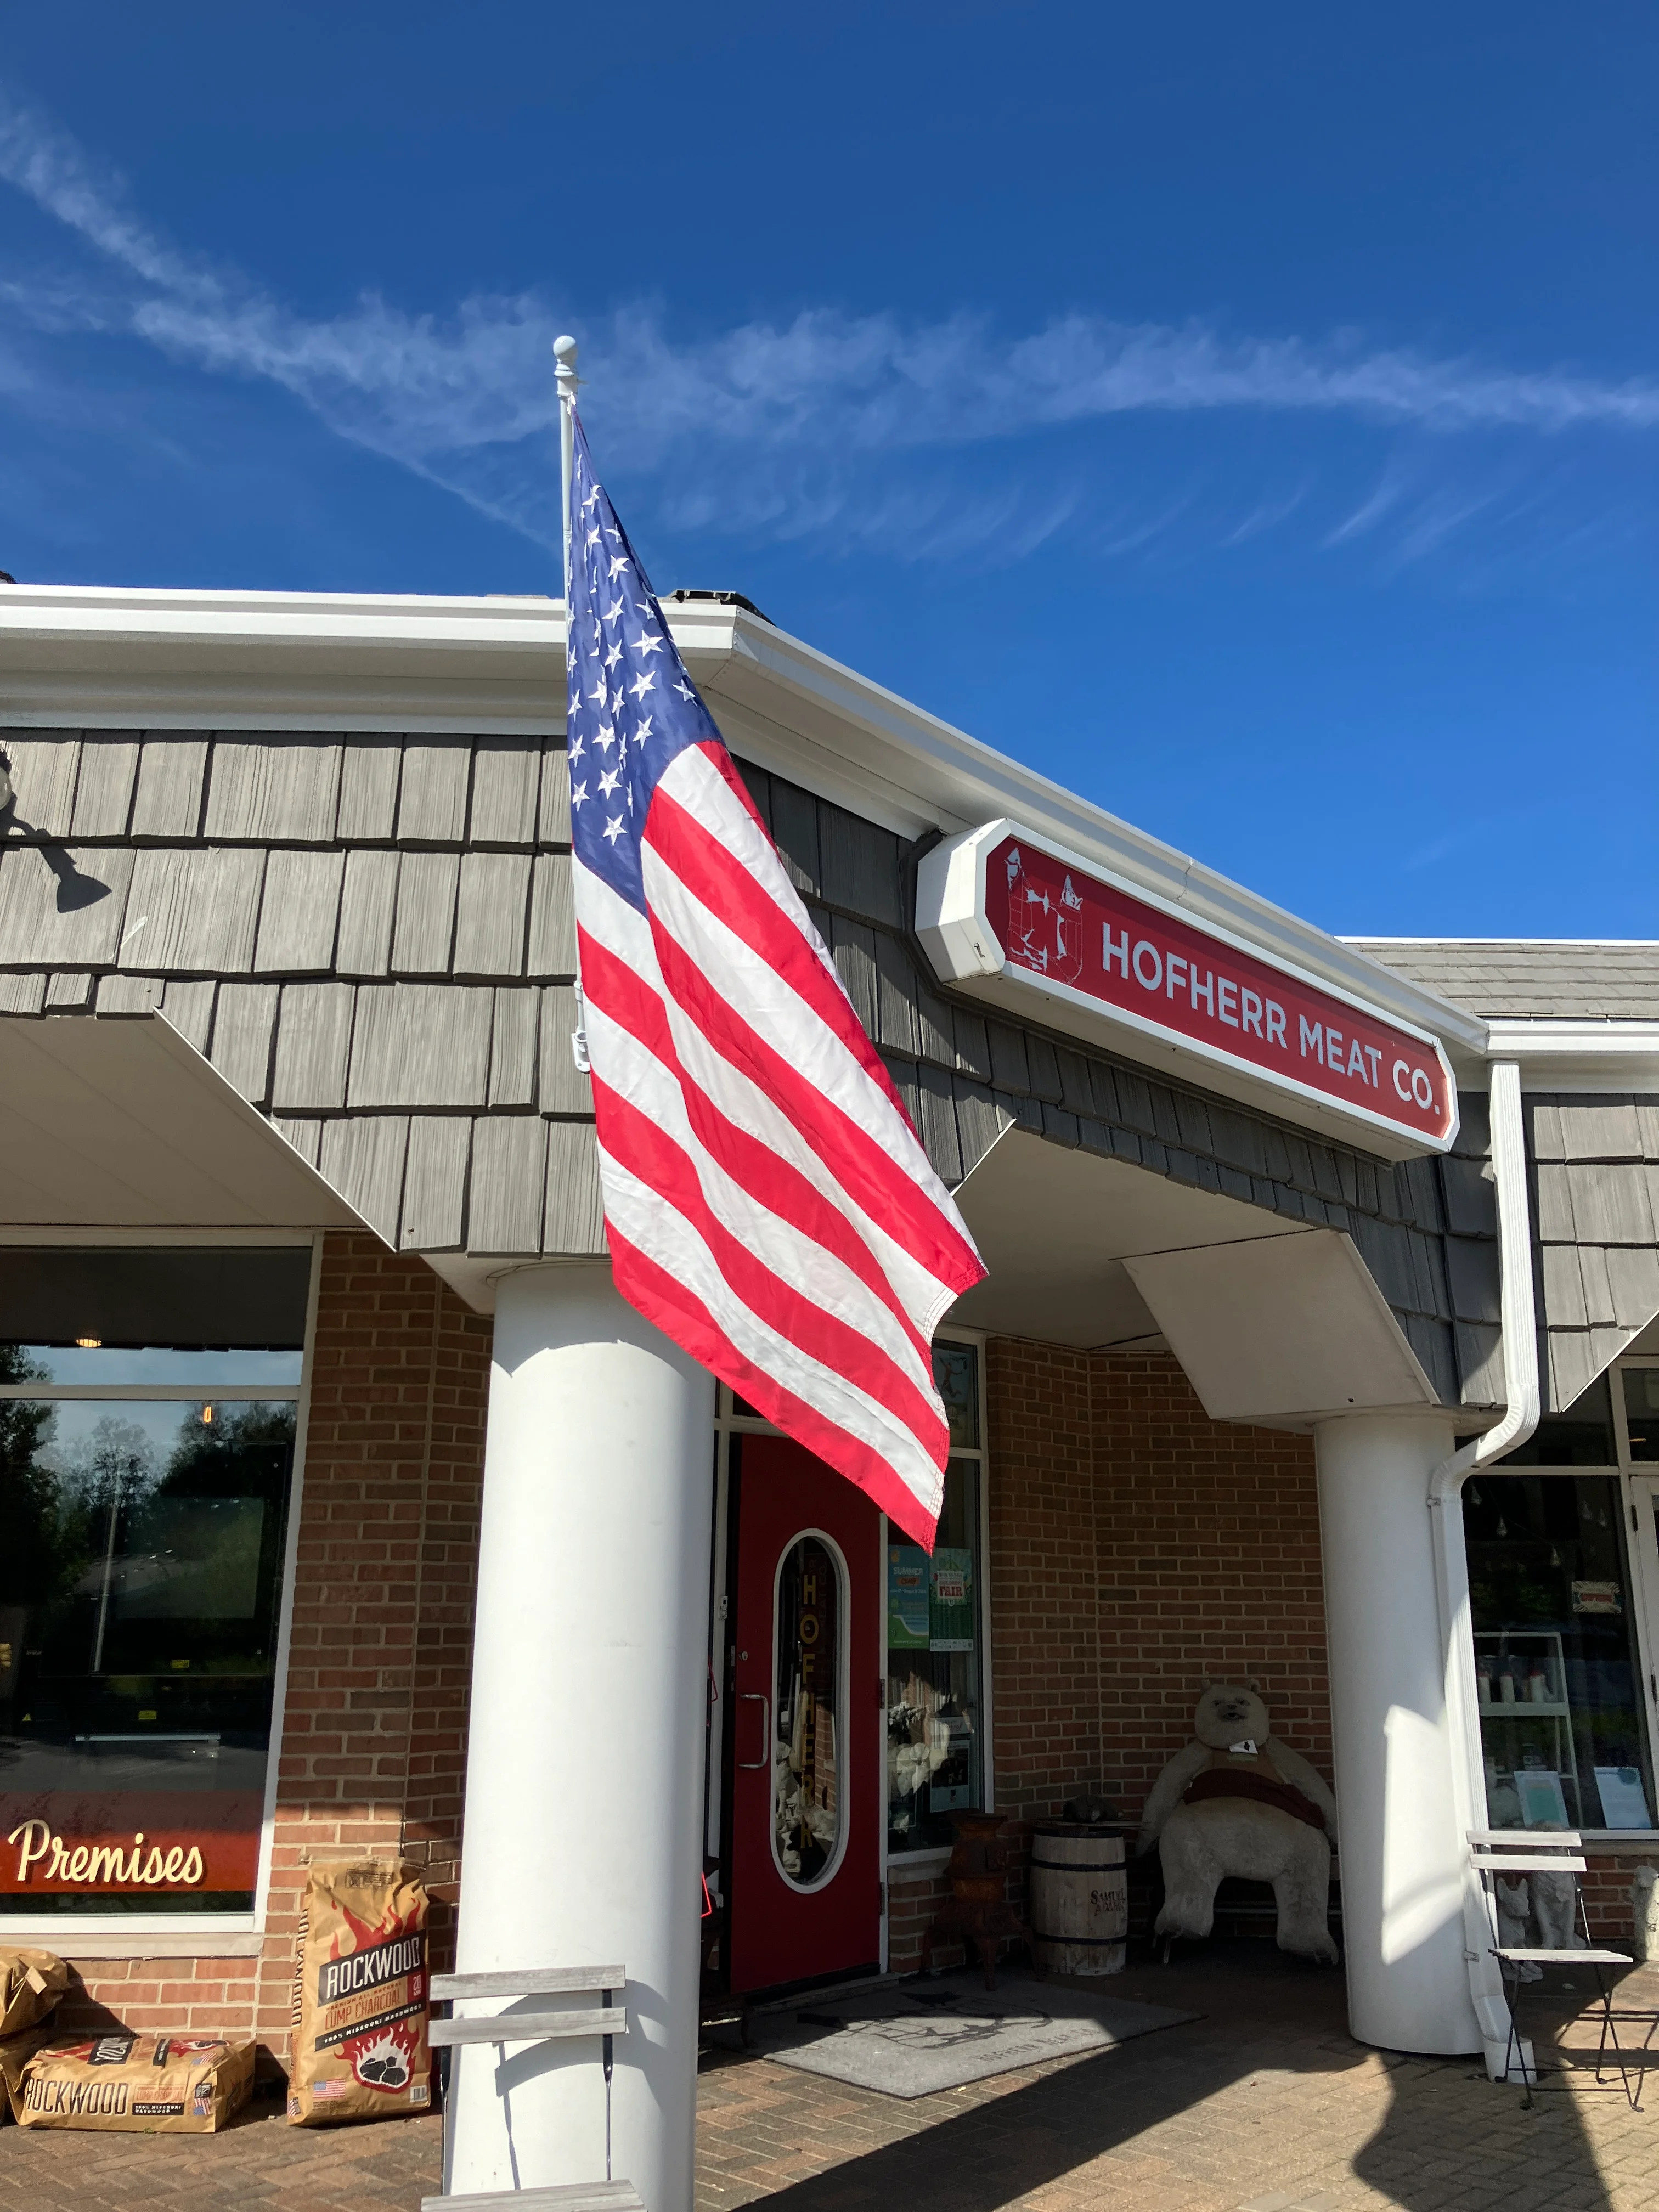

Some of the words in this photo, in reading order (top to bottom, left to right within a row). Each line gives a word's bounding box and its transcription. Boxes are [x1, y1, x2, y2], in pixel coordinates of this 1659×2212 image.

[1102, 921, 1288, 1049] HOFHERR
[1299, 1014, 1382, 1089] MEAT
[1393, 1059, 1441, 1115] CO.
[893, 1567, 923, 1576] SUMMER
[939, 1586, 963, 1596] FAIR
[799, 1573, 820, 1849] HOFHERR
[8, 1818, 204, 1885] Premises
[326, 1936, 421, 1999] ROCKWOOD
[413, 1974, 422, 1990] 20
[325, 2007, 352, 2030] LUMP
[355, 1988, 403, 2019] CHARCOAL
[346, 2018, 383, 2036] MISSOURI
